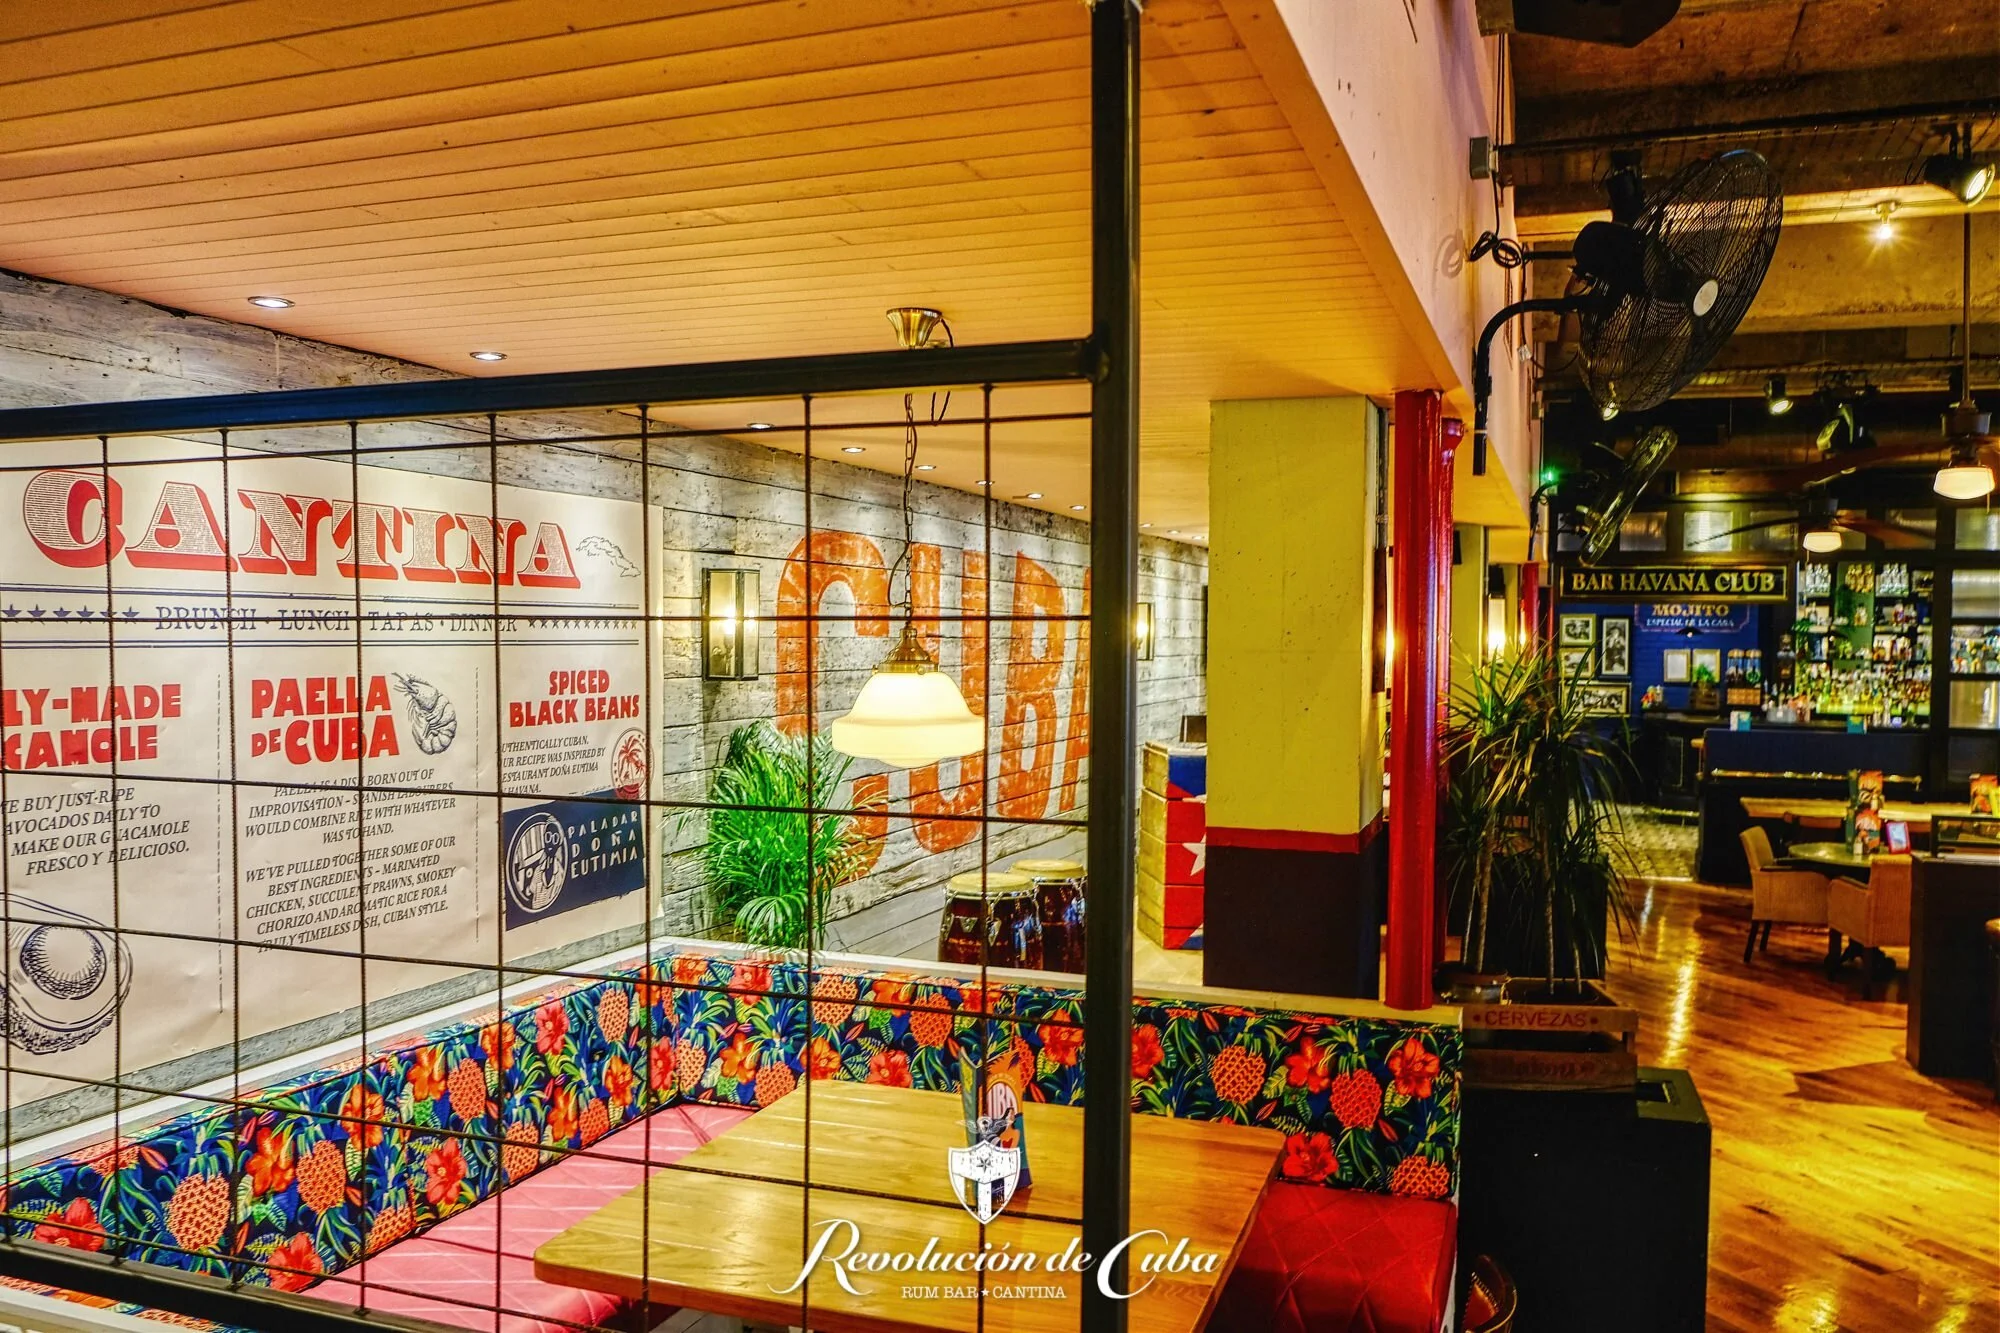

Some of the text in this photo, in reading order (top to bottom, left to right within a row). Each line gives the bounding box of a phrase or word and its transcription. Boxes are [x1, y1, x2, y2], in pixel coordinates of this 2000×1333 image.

[22, 469, 581, 589] CANTINA
[1572, 572, 1775, 592] BAR HAVANA CLUB
[156, 606, 256, 630] BRUNCH
[278, 610, 350, 630] LUNCH
[368, 611, 434, 632] TAPAS
[1652, 604, 1728, 616] MOJITO
[252, 676, 392, 718] PAELLA
[549, 670, 610, 696] SPICED
[2, 684, 182, 726] LY-MADE
[510, 694, 640, 728] BLACK BEANS
[252, 715, 400, 765] DE CUBA
[499, 736, 588, 753] UTHENTICALLY CUBAN.
[500, 761, 599, 782] ESTAURANT DOÑA EUTIMA
[501, 746, 606, 768] UR RECIPE WAS INSPIRED BY
[367, 772, 398, 786] BORN
[398, 769, 420, 782] OUT
[420, 768, 434, 780] OF
[24, 795, 56, 812] BUY
[246, 820, 290, 838] WOULD
[294, 812, 346, 830] COMBINE
[374, 804, 402, 819] WITH
[404, 798, 456, 814] WHATEVER
[249, 796, 344, 818] IMPROVISATION
[3, 812, 90, 836] AVOCADOS
[140, 804, 161, 819] TO
[323, 822, 394, 844] WAS TO HAND.
[568, 810, 638, 839] PALADAR
[11, 838, 59, 856] MAKE
[63, 832, 97, 849] OUR
[572, 829, 636, 858] DOÑA
[26, 853, 88, 875] FRESCO
[92, 851, 104, 866] Y
[246, 836, 456, 882] WE'VE PULLED TOGETHER SOME OF OUR
[571, 846, 638, 879] EUTIMIA
[268, 854, 440, 896] BEST INGREDIENTS MARINATED
[246, 896, 306, 919] CHICKEN,
[372, 875, 414, 894] PRAWNS,
[416, 866, 456, 884] SMOKEY
[257, 884, 448, 934] CHORIZO AND AROMATIC RICE FOR A
[298, 922, 351, 944] TIMELESS
[352, 915, 380, 932] DSH,
[384, 906, 416, 924] CUBAN
[418, 900, 448, 916] STYLE.
[1485, 1010, 1586, 1028] CERVEZAS
